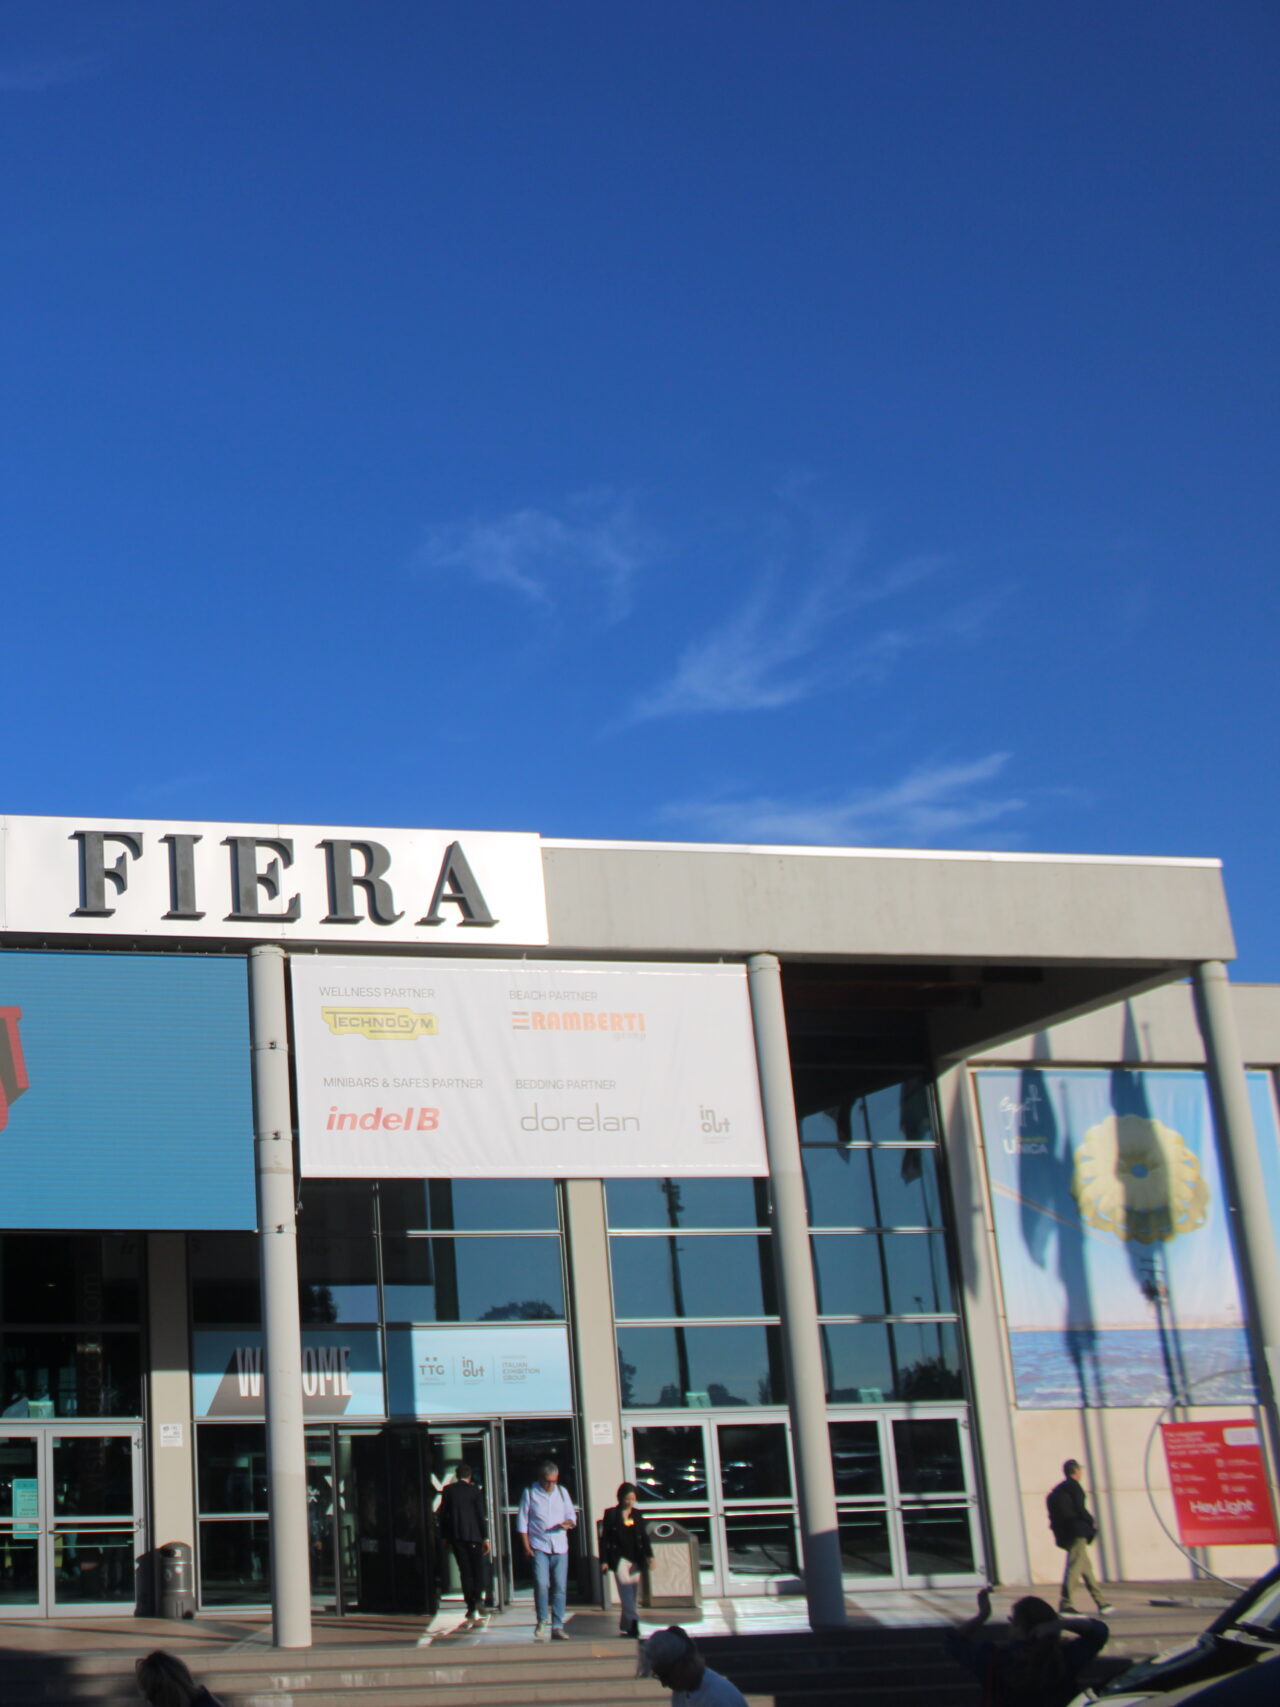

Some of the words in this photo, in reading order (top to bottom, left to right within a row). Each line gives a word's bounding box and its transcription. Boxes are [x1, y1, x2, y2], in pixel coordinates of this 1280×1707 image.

[69, 830, 498, 927] FIERA
[319, 986, 381, 998] WELLNESS
[384, 987, 435, 998] PARTNER
[509, 991, 546, 1001] BEACH
[549, 991, 598, 1001] PARTNER
[531, 1011, 646, 1032] RAMBERTI
[323, 1077, 379, 1088] MINIBARS
[382, 1077, 390, 1088] &
[393, 1078, 430, 1089] SAFES
[432, 1078, 483, 1089] PARTNER
[516, 1079, 564, 1090] BEDDING
[567, 1080, 617, 1090] PARTNER
[520, 1102, 641, 1132] dorelan
[236, 1346, 352, 1397] WOME
